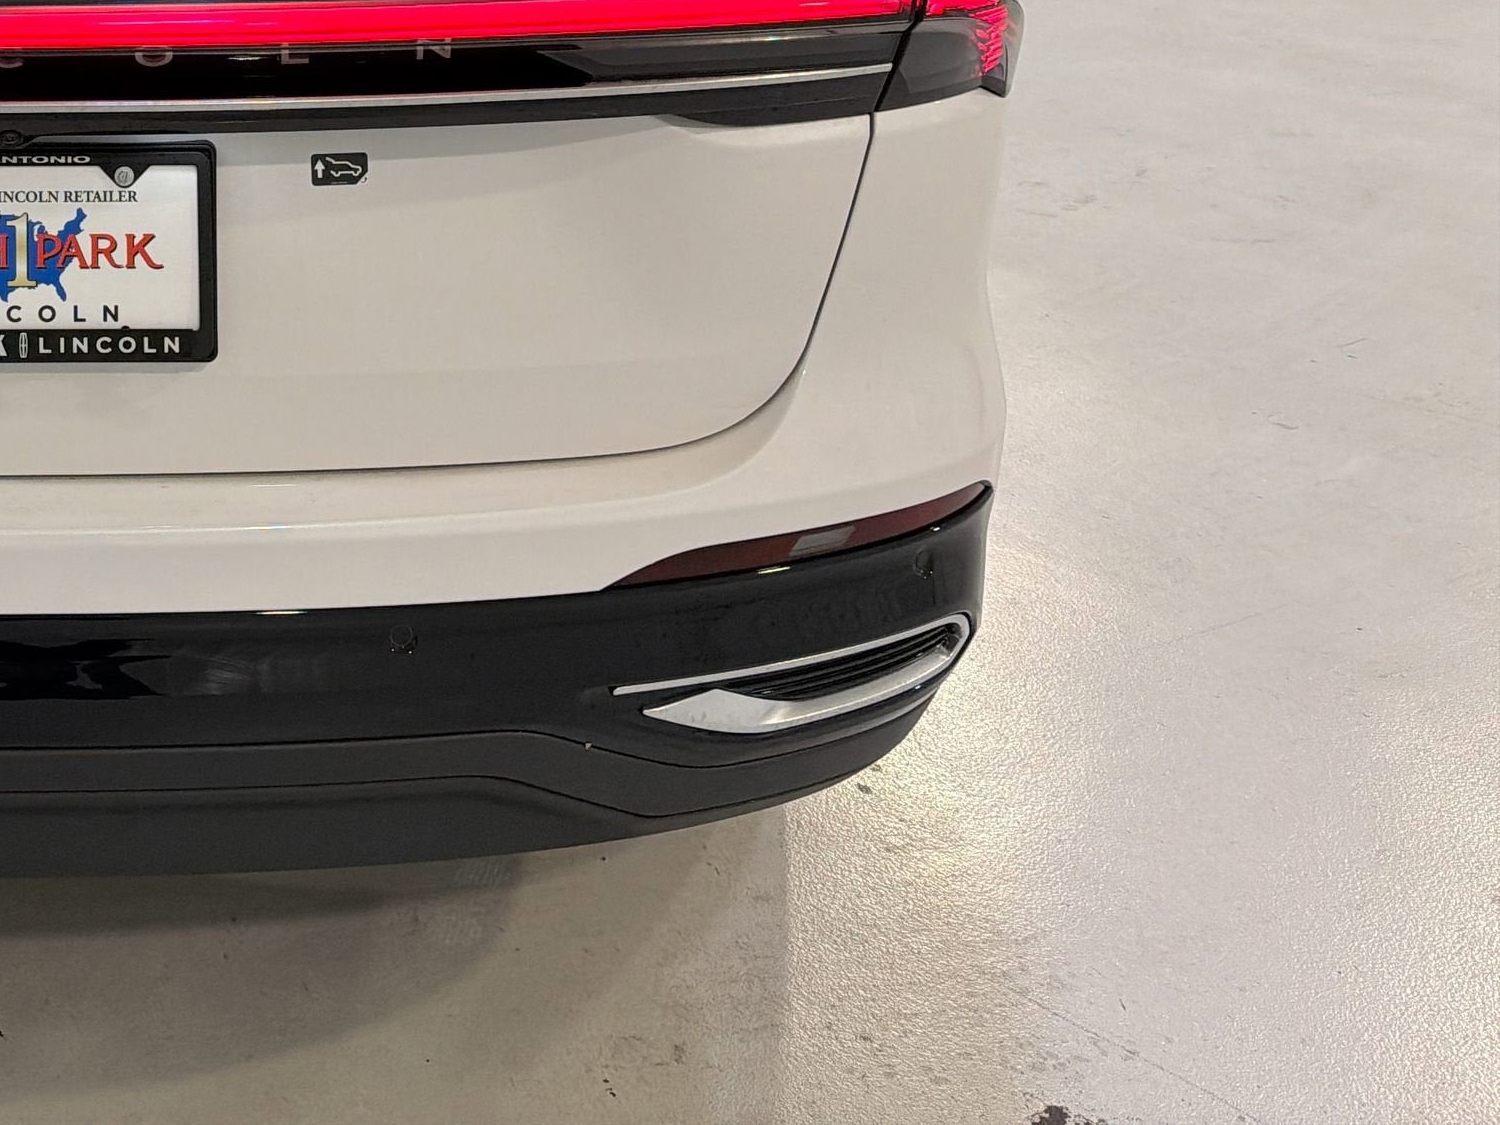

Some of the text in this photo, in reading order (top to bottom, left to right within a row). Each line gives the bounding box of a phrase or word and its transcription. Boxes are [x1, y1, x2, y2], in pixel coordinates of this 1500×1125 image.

[64, 189, 138, 204] RETAILER
[36, 233, 165, 270] PARK
[38, 336, 181, 355] LINCOLN
